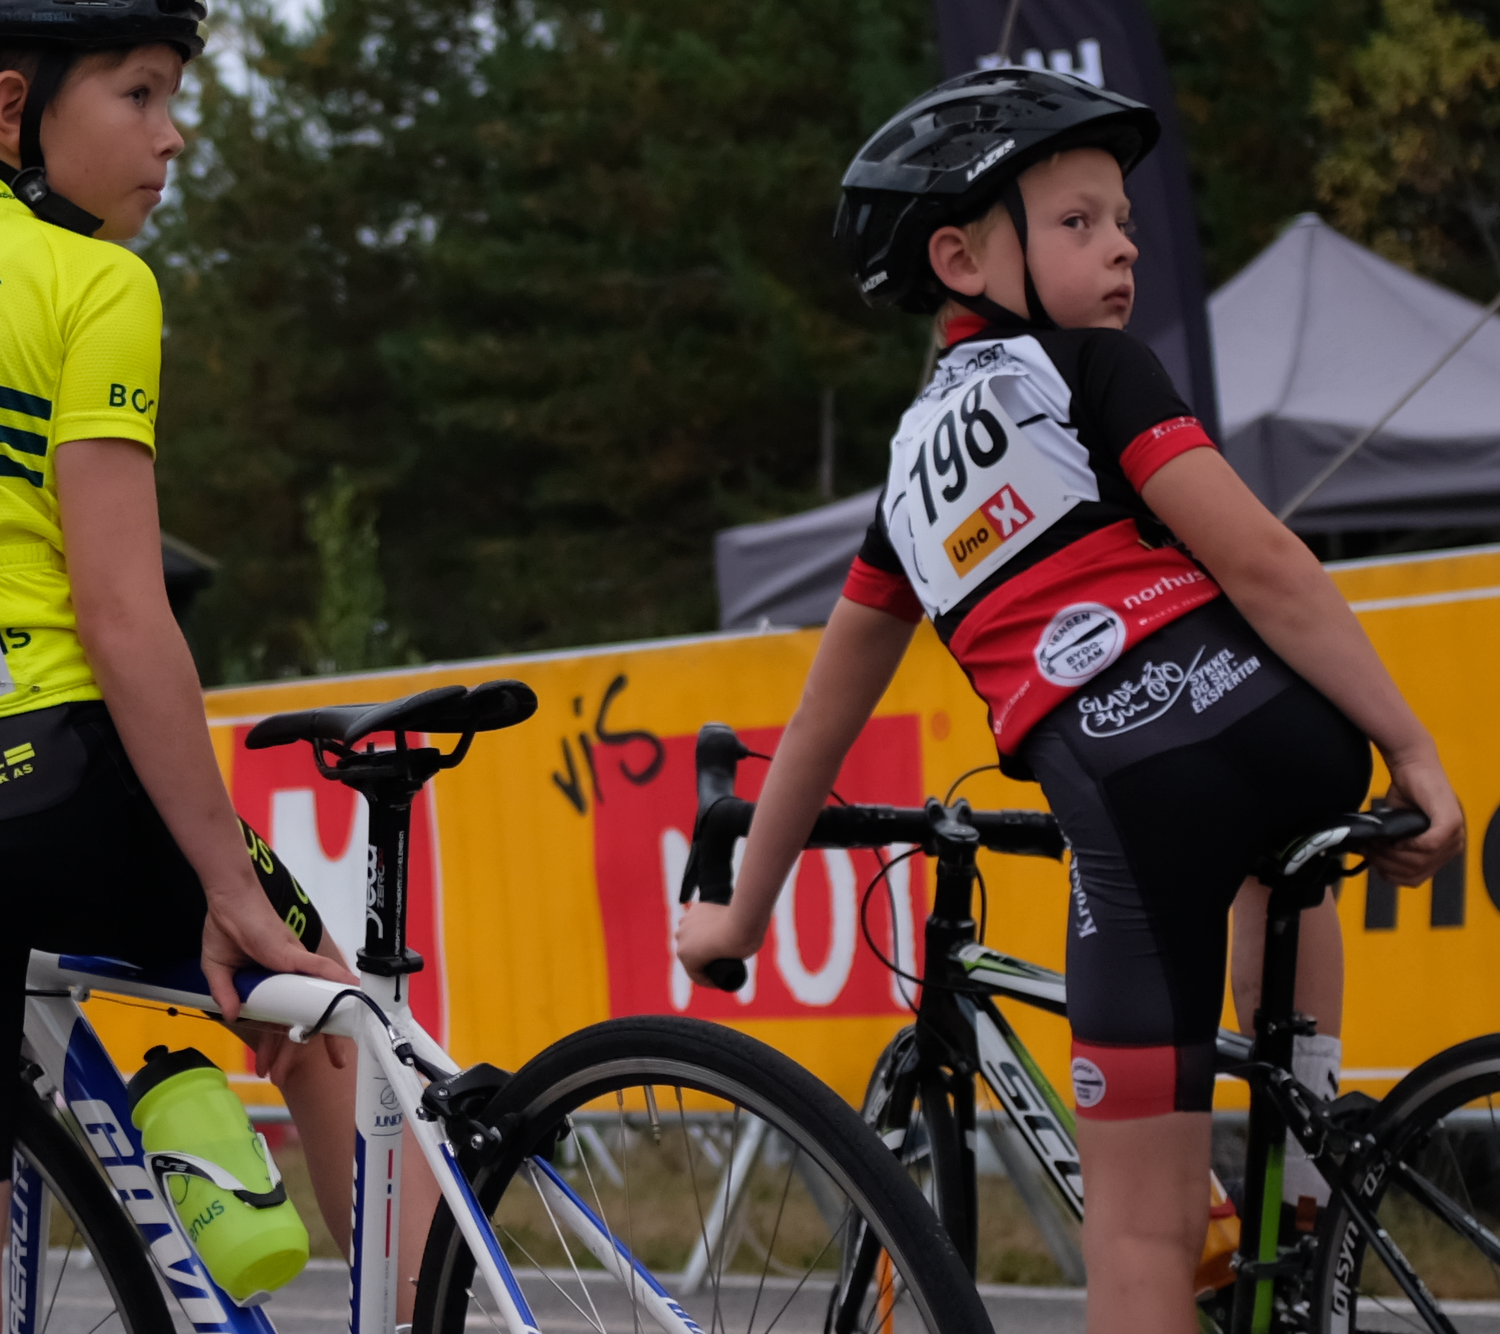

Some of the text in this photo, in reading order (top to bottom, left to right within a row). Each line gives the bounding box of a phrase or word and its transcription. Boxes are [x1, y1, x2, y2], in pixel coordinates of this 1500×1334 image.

[909, 379, 1008, 527] 198
[953, 488, 1027, 563] Uno X
[1122, 571, 1207, 611] norhus
[1071, 648, 1105, 673] TEAM
[1191, 655, 1262, 715] EKSPERTEN
[13, 763, 34, 779] AS
